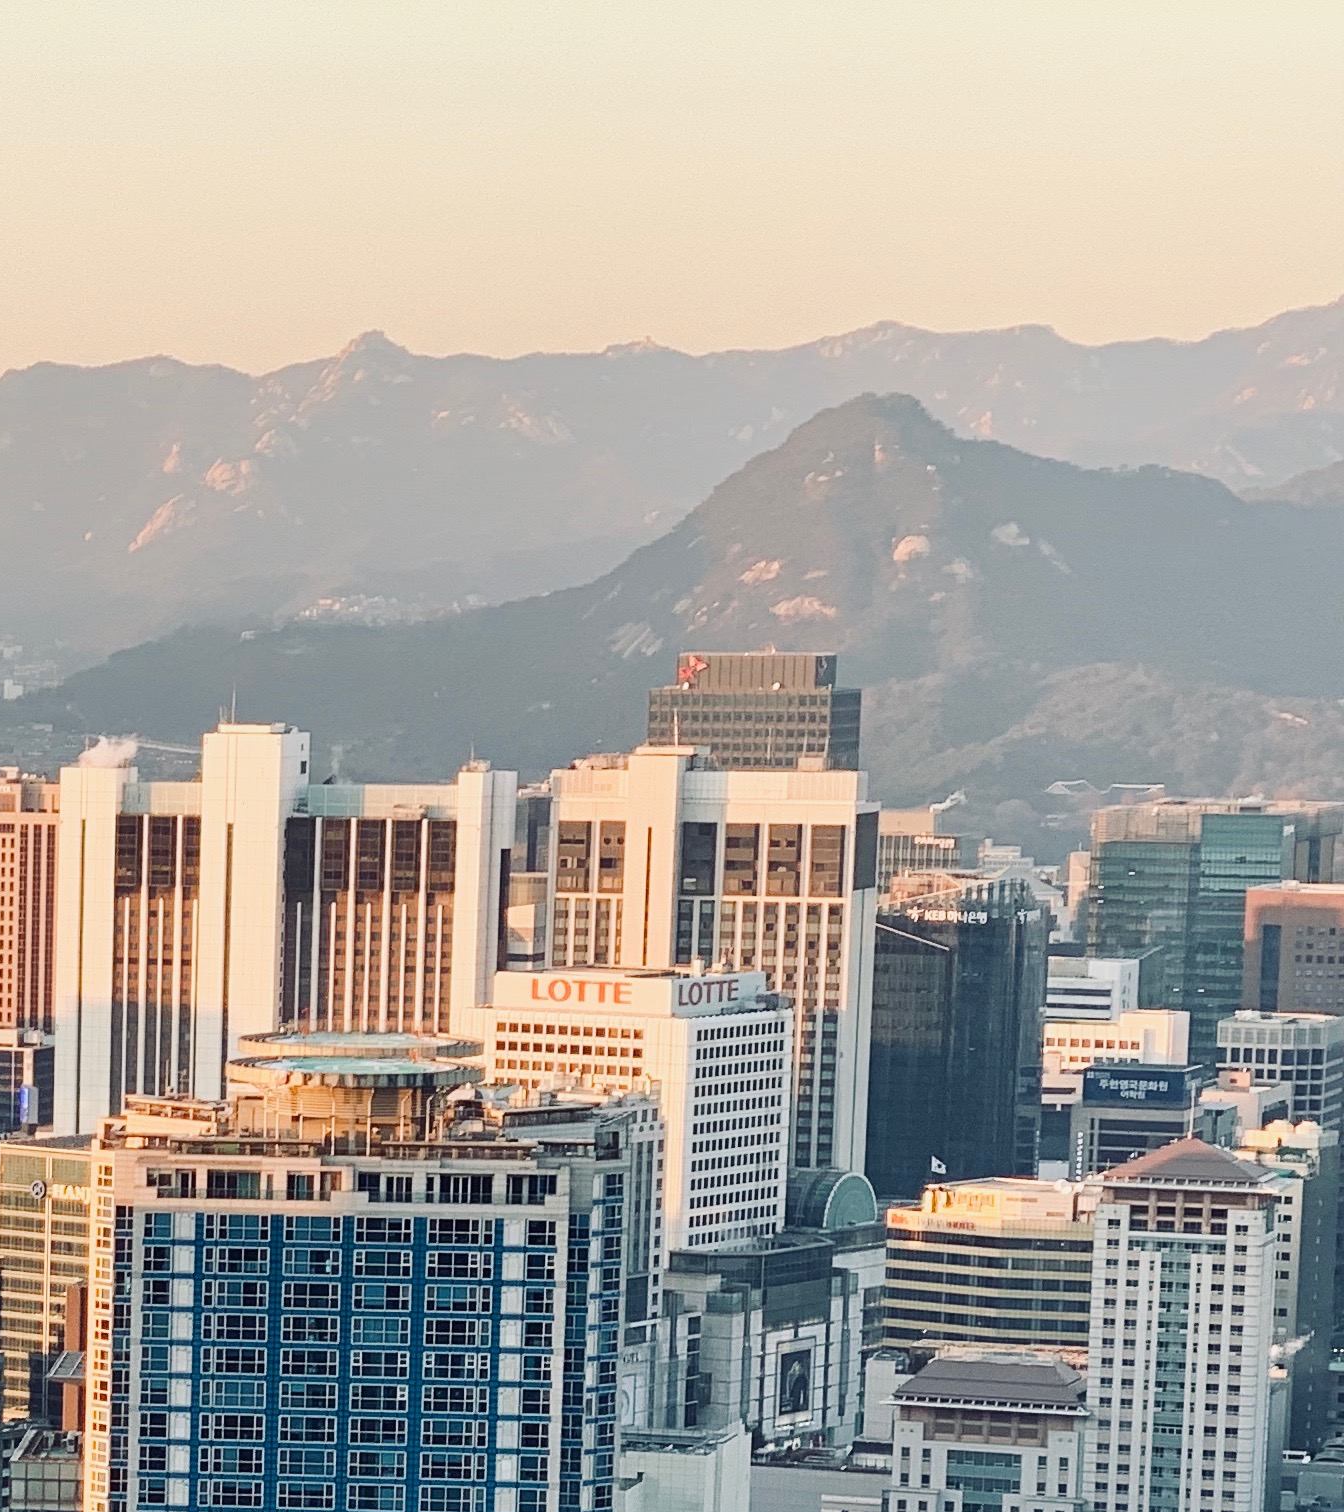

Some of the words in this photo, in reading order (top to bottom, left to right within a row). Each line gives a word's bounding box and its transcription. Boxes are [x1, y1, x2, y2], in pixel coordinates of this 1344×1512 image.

[924, 909, 948, 919] KEB
[949, 910, 988, 924] 하나은행
[531, 979, 632, 1005] LOTTE
[678, 979, 740, 1007] LOTTE
[1098, 1079, 1169, 1092] 주한영국문화원
